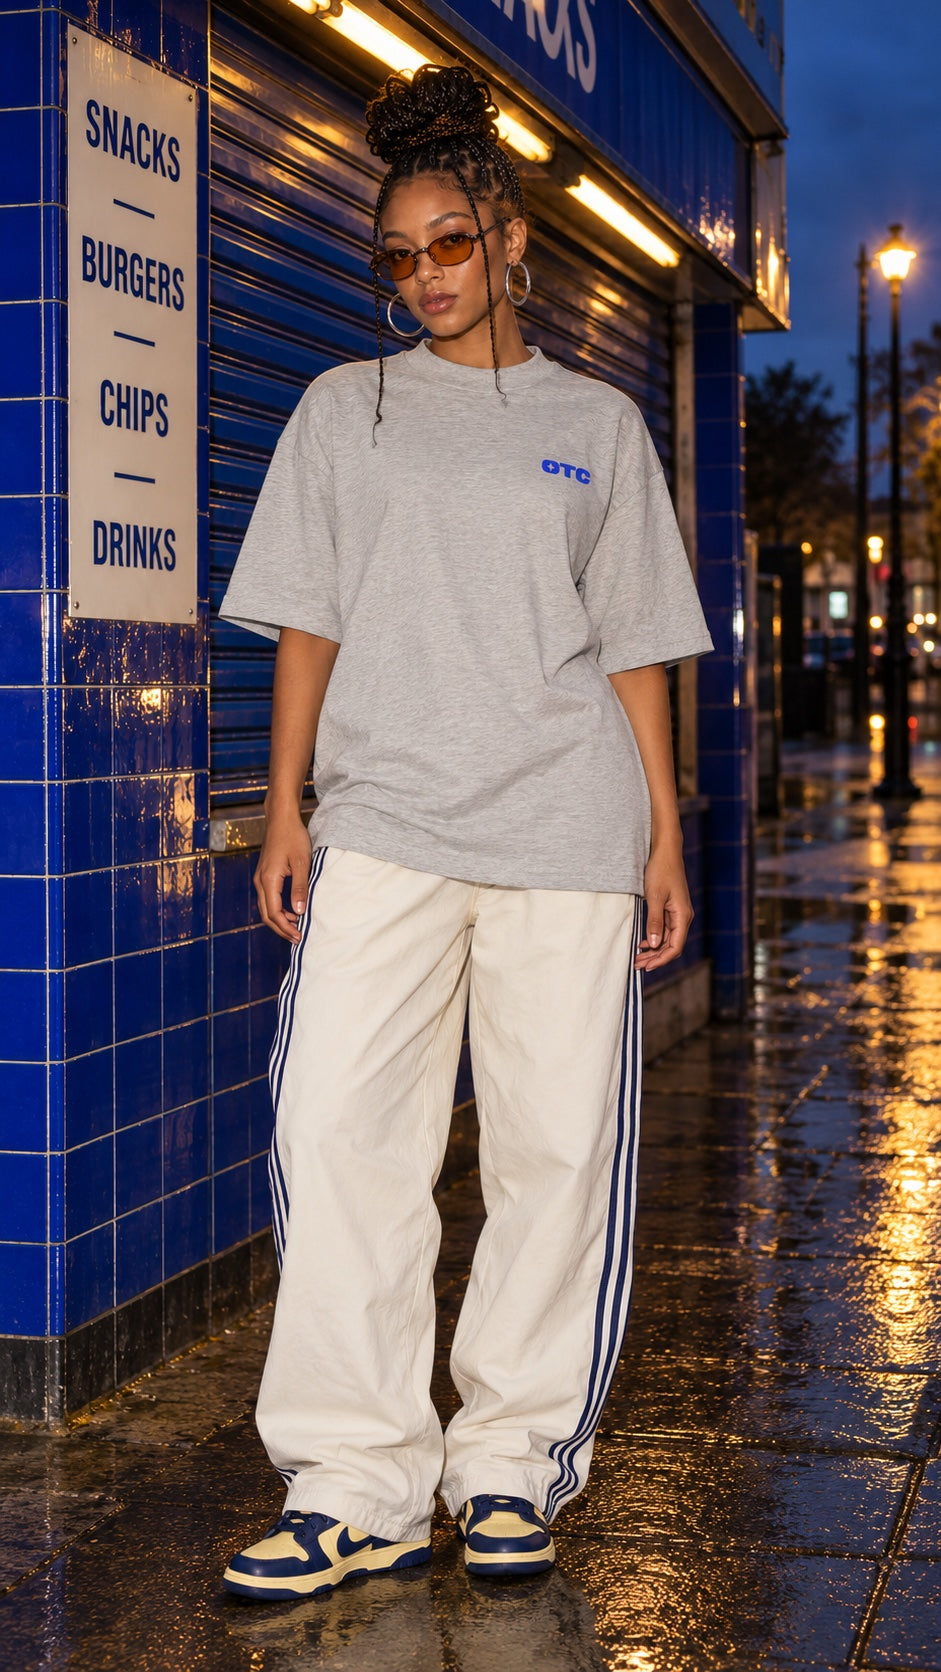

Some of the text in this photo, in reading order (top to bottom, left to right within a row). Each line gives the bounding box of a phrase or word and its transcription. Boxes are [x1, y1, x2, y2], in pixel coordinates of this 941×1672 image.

[86, 99, 181, 182] SNACKS
[82, 235, 185, 312] BURGERS
[100, 379, 169, 438] CHIPS
[541, 459, 591, 485] OTC
[93, 520, 177, 572] DRINKS
